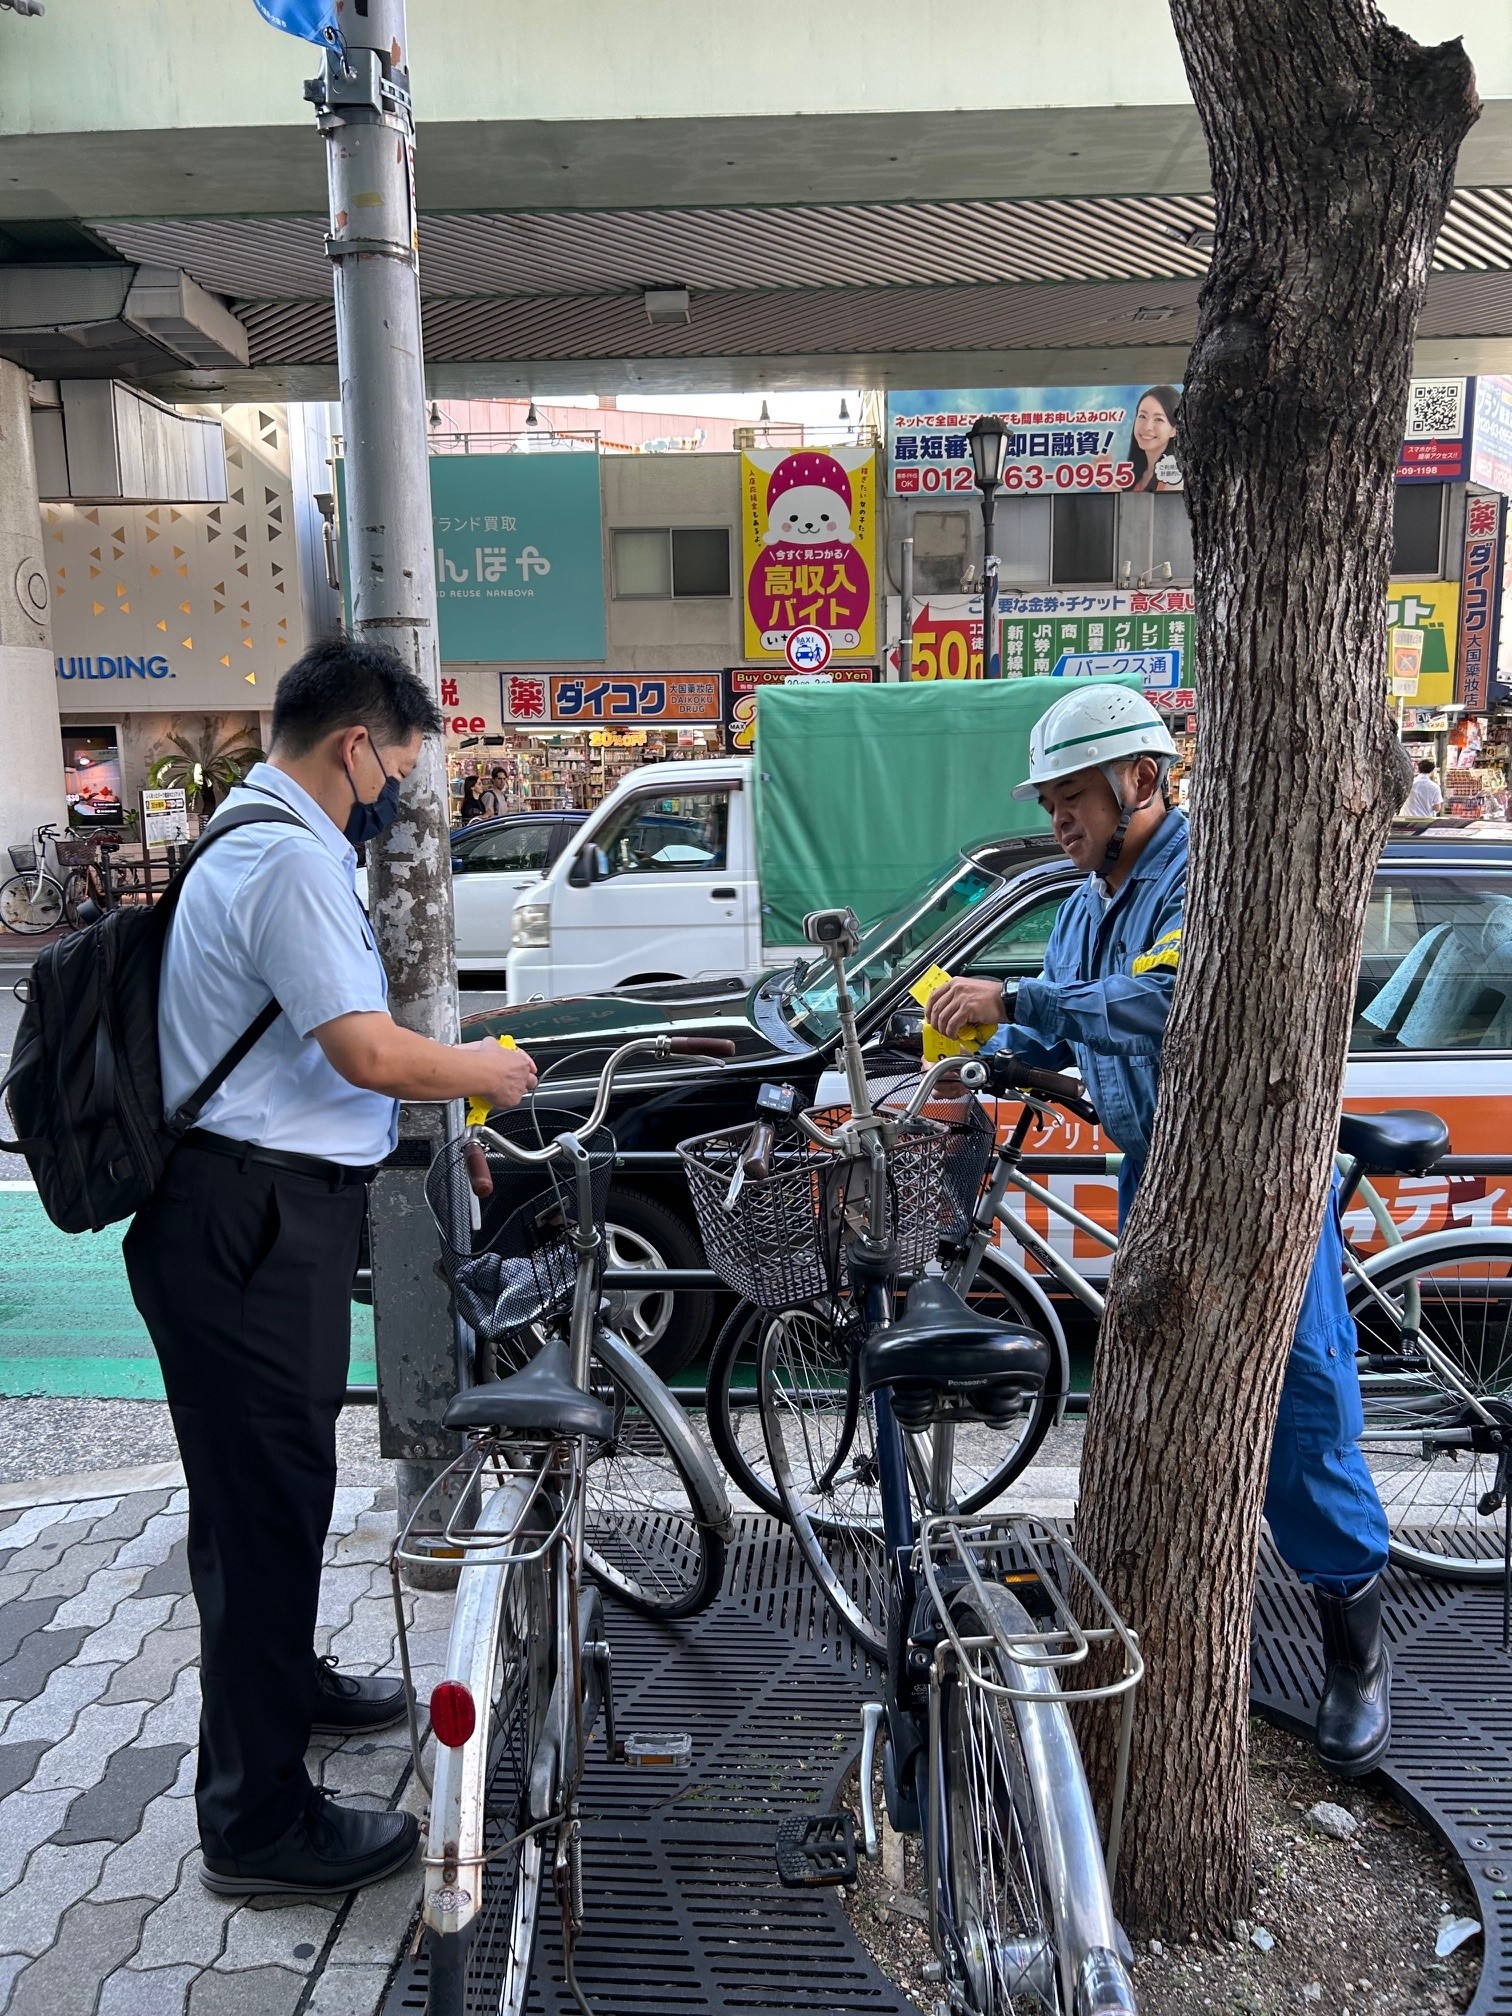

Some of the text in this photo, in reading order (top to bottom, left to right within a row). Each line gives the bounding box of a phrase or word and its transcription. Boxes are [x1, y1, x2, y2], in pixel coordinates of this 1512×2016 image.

[895, 430, 1115, 460] 最短審即日融資!
[922, 463, 1135, 492] 01263-0955
[433, 516, 518, 532] ランド買取
[1469, 499, 1497, 537] 薬
[437, 545, 551, 583] んぼや
[763, 564, 857, 596] 高収入
[1465, 542, 1493, 632] ダイコク
[450, 589, 481, 598] REUSE
[486, 589, 534, 598] NANBOYA
[768, 598, 851, 627] バイト
[968, 595, 1126, 615] ご要な金券・チケット
[796, 636, 814, 644] TAXI
[55, 655, 177, 680] UILDING.
[737, 673, 760, 683] Buy
[763, 673, 786, 682] Ove
[846, 672, 868, 680] Yen
[508, 676, 667, 718] 薬 ダイコク
[671, 696, 713, 704] DAIKOKU
[679, 705, 706, 713] DRUG
[442, 715, 486, 735] ree
[947, 1378, 988, 1387] Panasonic
